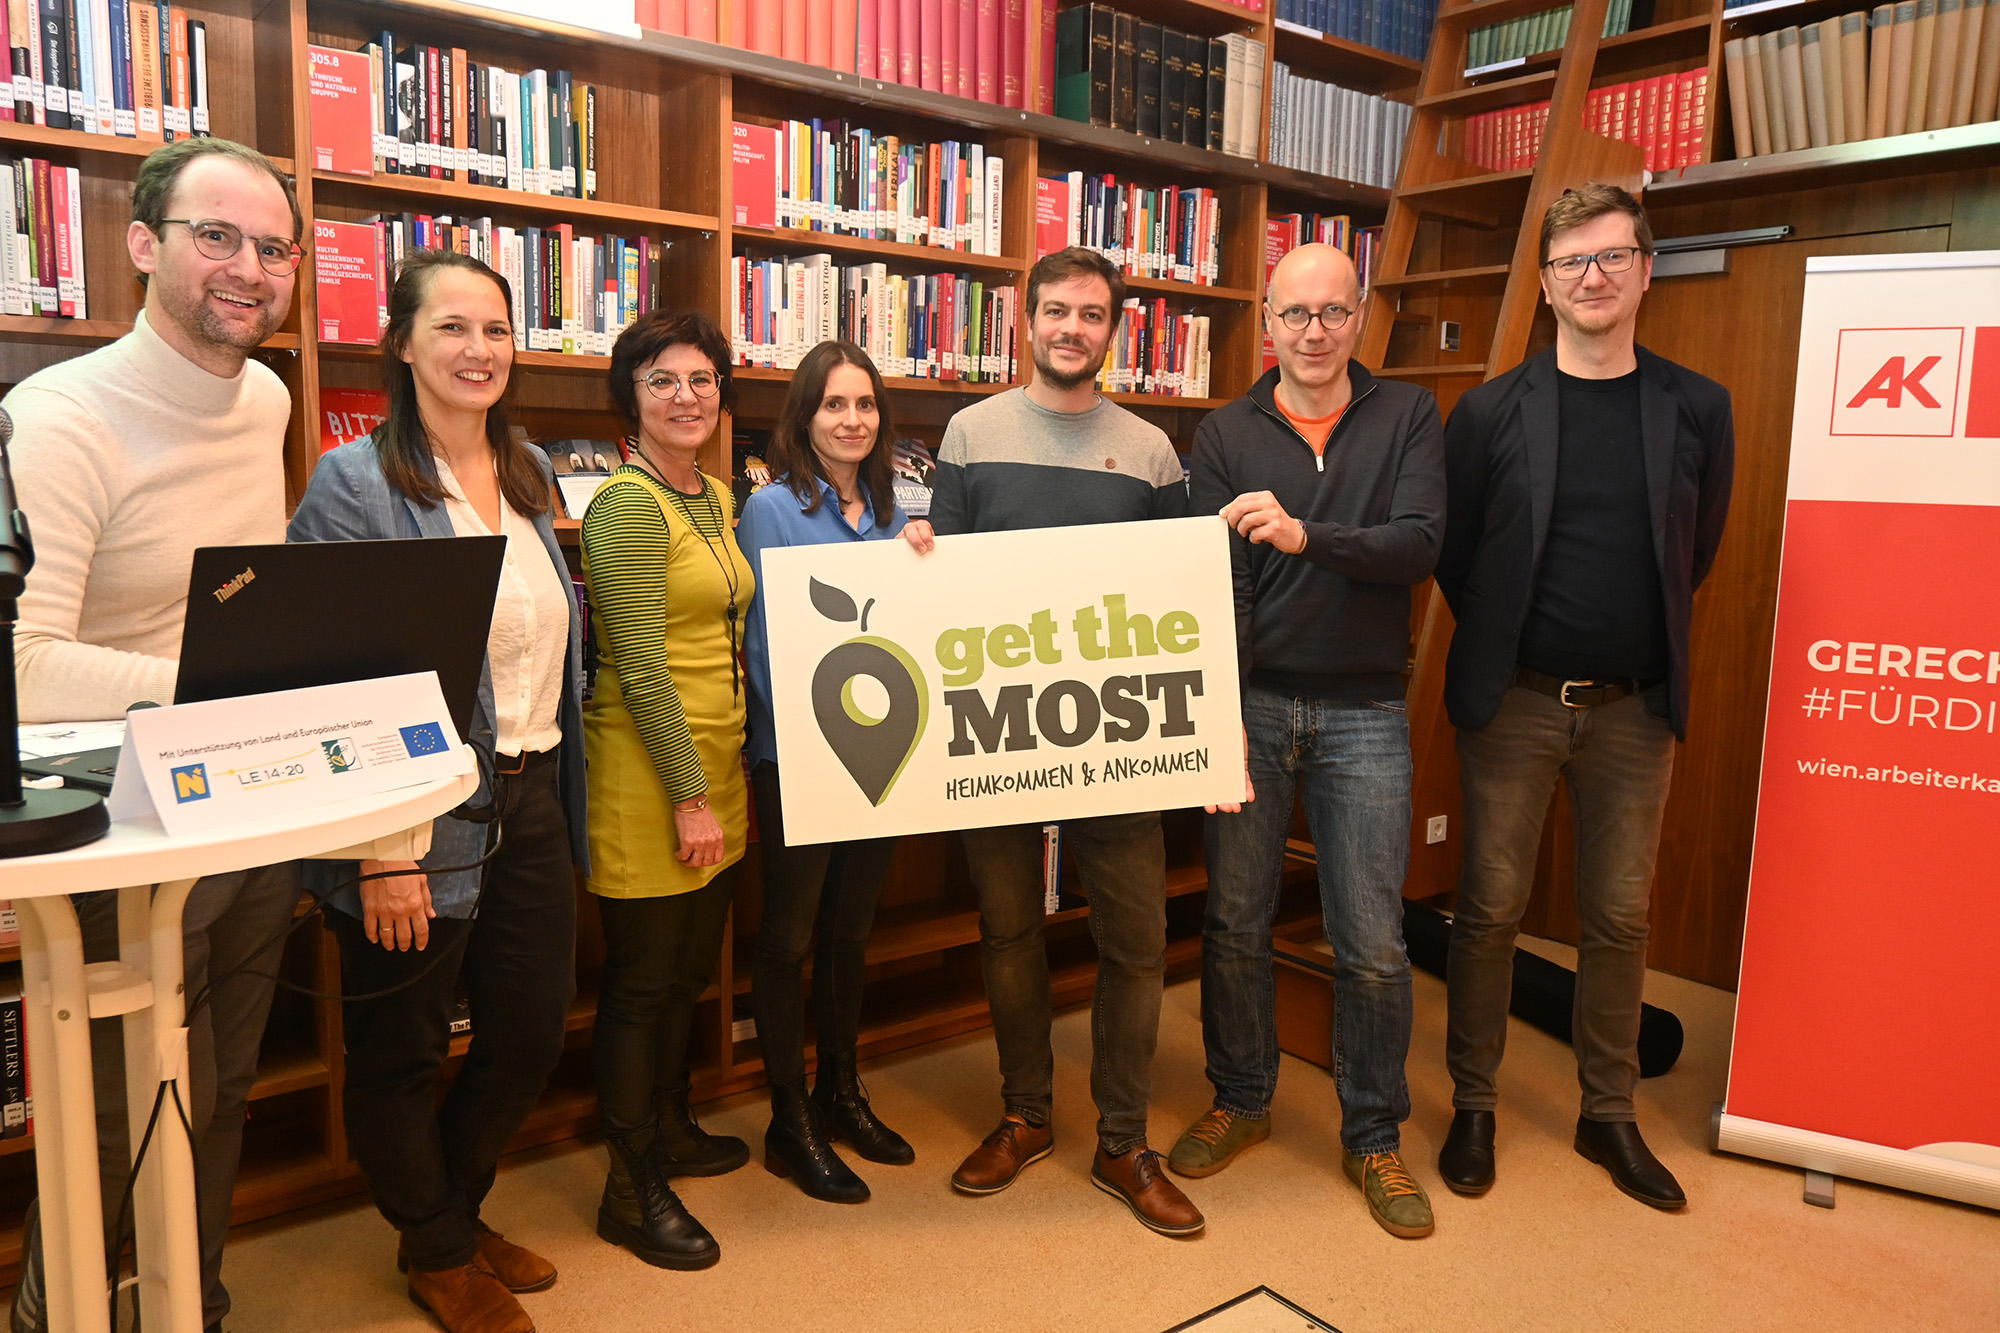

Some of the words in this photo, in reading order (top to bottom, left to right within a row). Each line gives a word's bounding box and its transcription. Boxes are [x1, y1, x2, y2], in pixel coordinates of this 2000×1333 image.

[139, 10, 152, 61] ANTIRASSISMUS
[142, 62, 152, 76] DES
[310, 52, 340, 68] 305.8
[442, 55, 450, 84] IDENTITÄT
[311, 73, 343, 83] ETHNISCHE
[311, 80, 324, 89] UND
[325, 83, 358, 94] NATIONALE
[311, 88, 339, 98] GRUPPEN
[733, 126, 748, 137] 320
[733, 156, 750, 164] POLITIK
[1038, 181, 1049, 191] 324
[5, 210, 14, 273] INTERNETKINDER
[316, 227, 336, 238] 306
[59, 223, 70, 271] BALKANALIEN
[316, 246, 339, 254] KULTUR
[317, 254, 366, 265] (MASSENKULTUR,
[317, 261, 361, 272] SUBKULTUREN)
[318, 269, 374, 280] SOZIALGESCHICHTE,
[318, 277, 341, 285] FAMILIE
[796, 270, 804, 320] PUTINLAND
[1846, 356, 1942, 409] AK
[212, 566, 256, 603] ThinkPad
[935, 608, 1062, 687] get
[1072, 593, 1200, 662] the
[1807, 639, 2000, 684] GERECH
[943, 669, 1204, 757] MOST
[1802, 685, 1996, 734] #FÜRDI
[159, 750, 175, 760] Mit
[176, 740, 242, 758] Unterstützung
[242, 738, 258, 746] von
[259, 732, 281, 744] Land
[282, 730, 299, 740] und
[299, 722, 350, 738] Europäischer
[350, 719, 374, 729] Union
[238, 769, 261, 785] LE
[263, 763, 305, 781] 14-20
[946, 763, 1073, 800] HEIMKOMMEN
[1082, 761, 1096, 786] &
[1103, 747, 1209, 783] ANKOMMEN
[1797, 757, 2000, 793] wien.arbeiterka
[4, 1009, 19, 1078] SETTLERS
